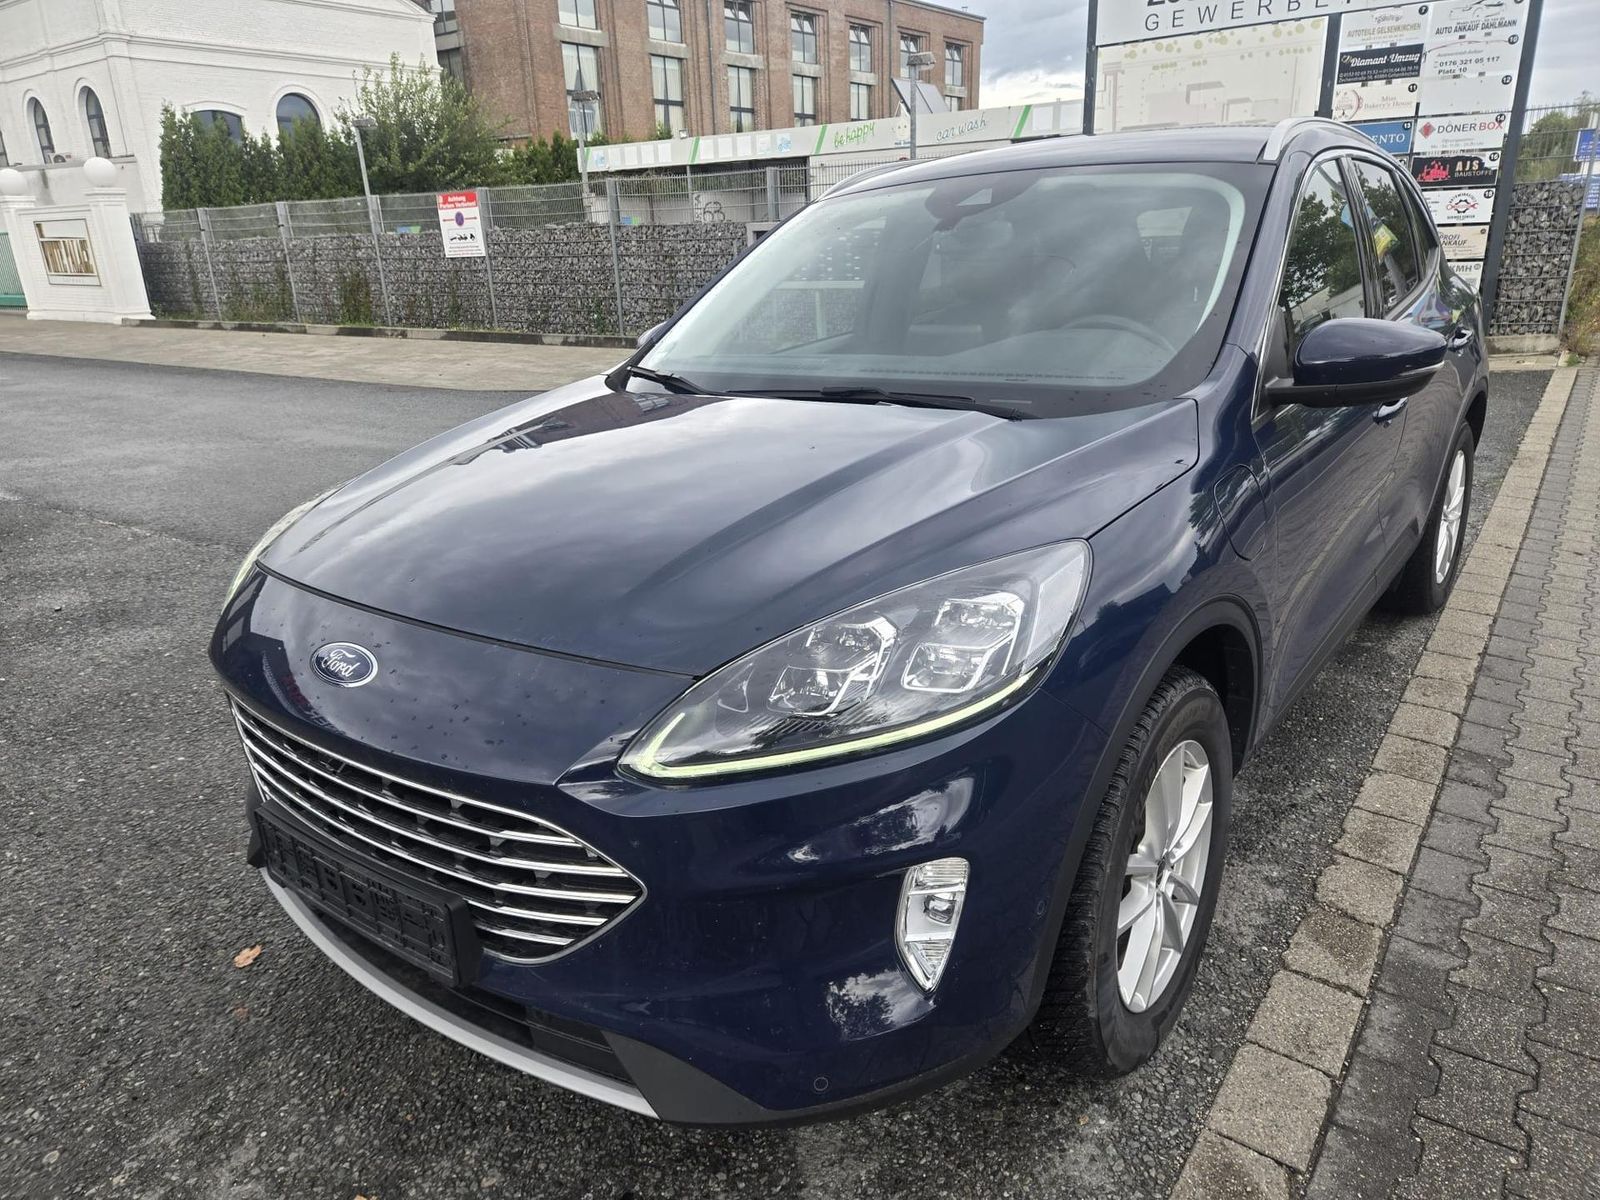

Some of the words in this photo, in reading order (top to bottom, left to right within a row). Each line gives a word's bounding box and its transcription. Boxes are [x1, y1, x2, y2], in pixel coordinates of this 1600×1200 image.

[1346, 27, 1375, 38] AUTOTEILE
[1377, 23, 1421, 34] GELSENKIRCHEN
[1435, 26, 1453, 35] AUTO
[1454, 23, 1480, 33] ANKAUF
[1481, 20, 1518, 31] DAHLMANN
[846, 121, 875, 145] happy
[936, 127, 955, 141] car
[958, 111, 987, 136] wash
[1479, 121, 1503, 131] BOX
[321, 648, 361, 677] Ford
